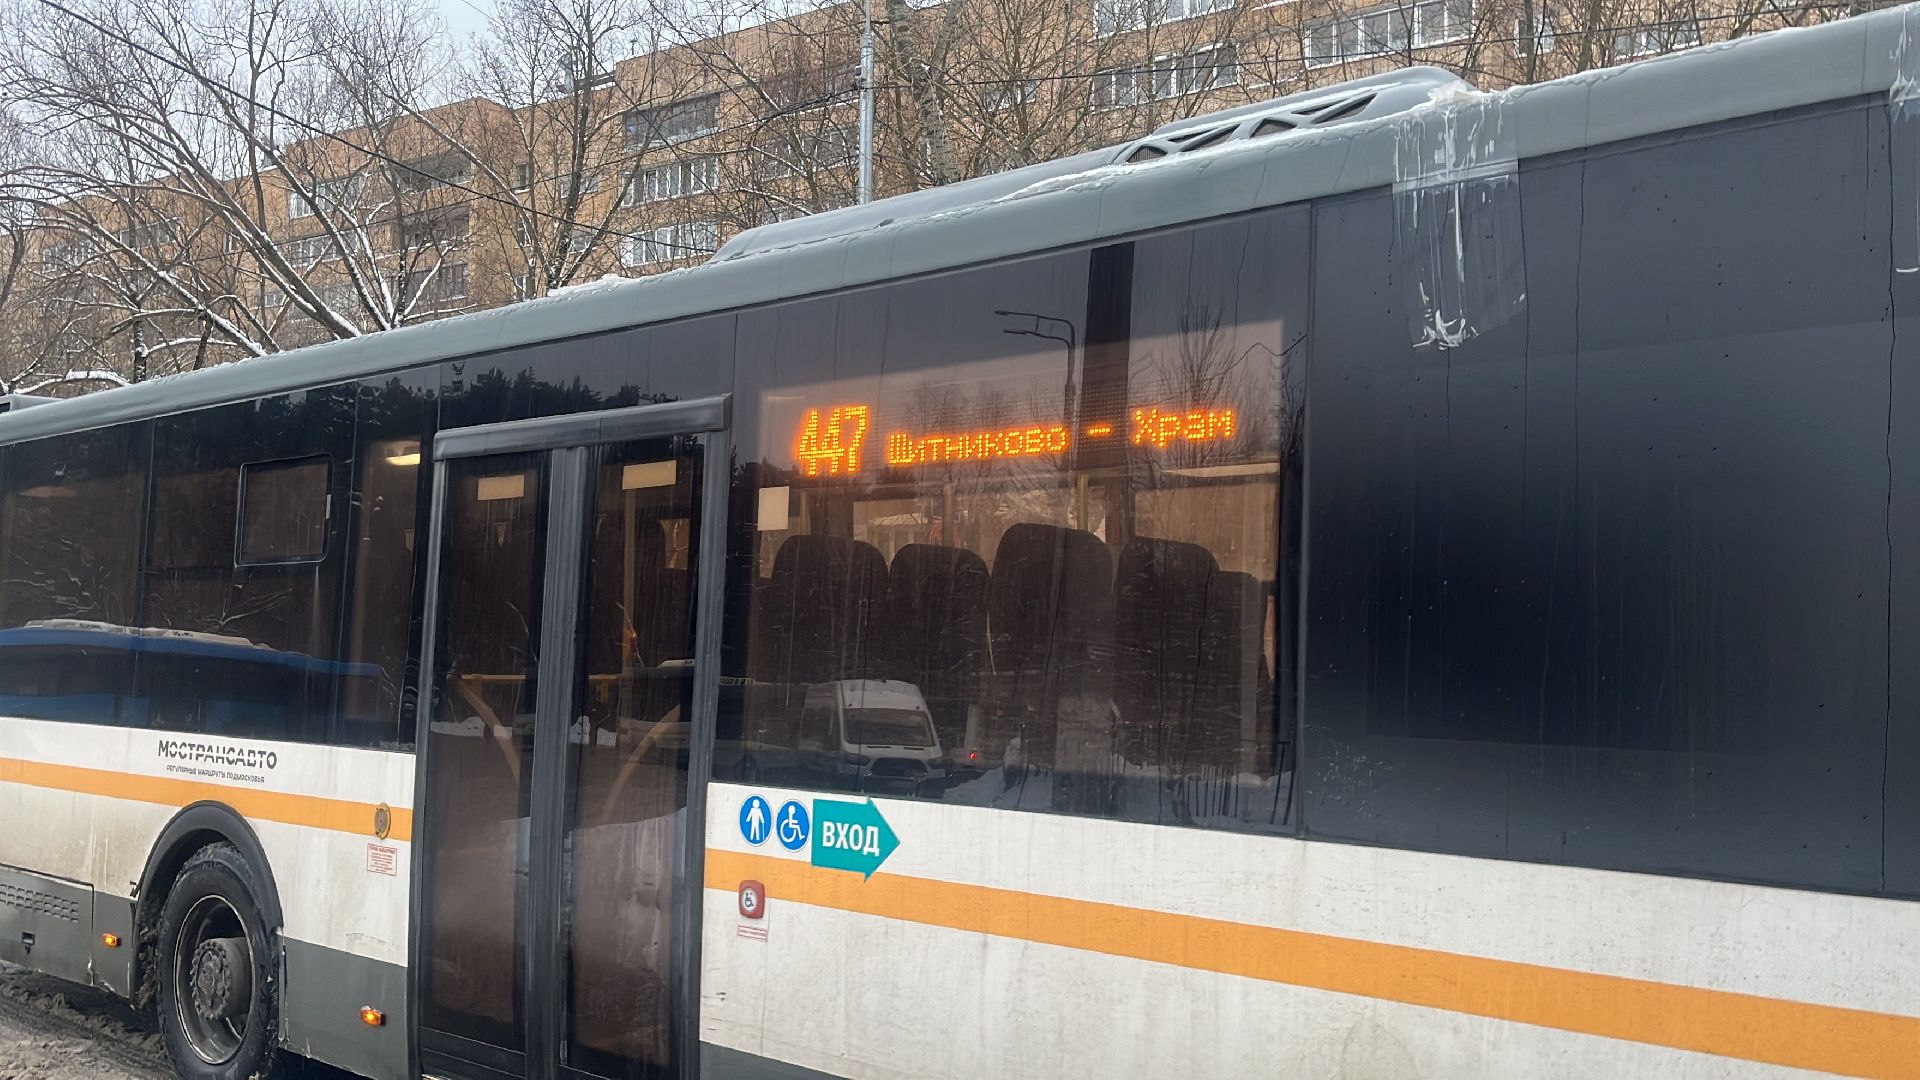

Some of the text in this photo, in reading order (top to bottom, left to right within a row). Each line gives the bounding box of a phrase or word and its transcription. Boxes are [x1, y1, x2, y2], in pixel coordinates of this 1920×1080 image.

[799, 405, 867, 476] 447
[1134, 408, 1233, 448] Храм
[158, 740, 278, 769] МОСТРАНСАВТО
[822, 821, 880, 857] ВХОД
